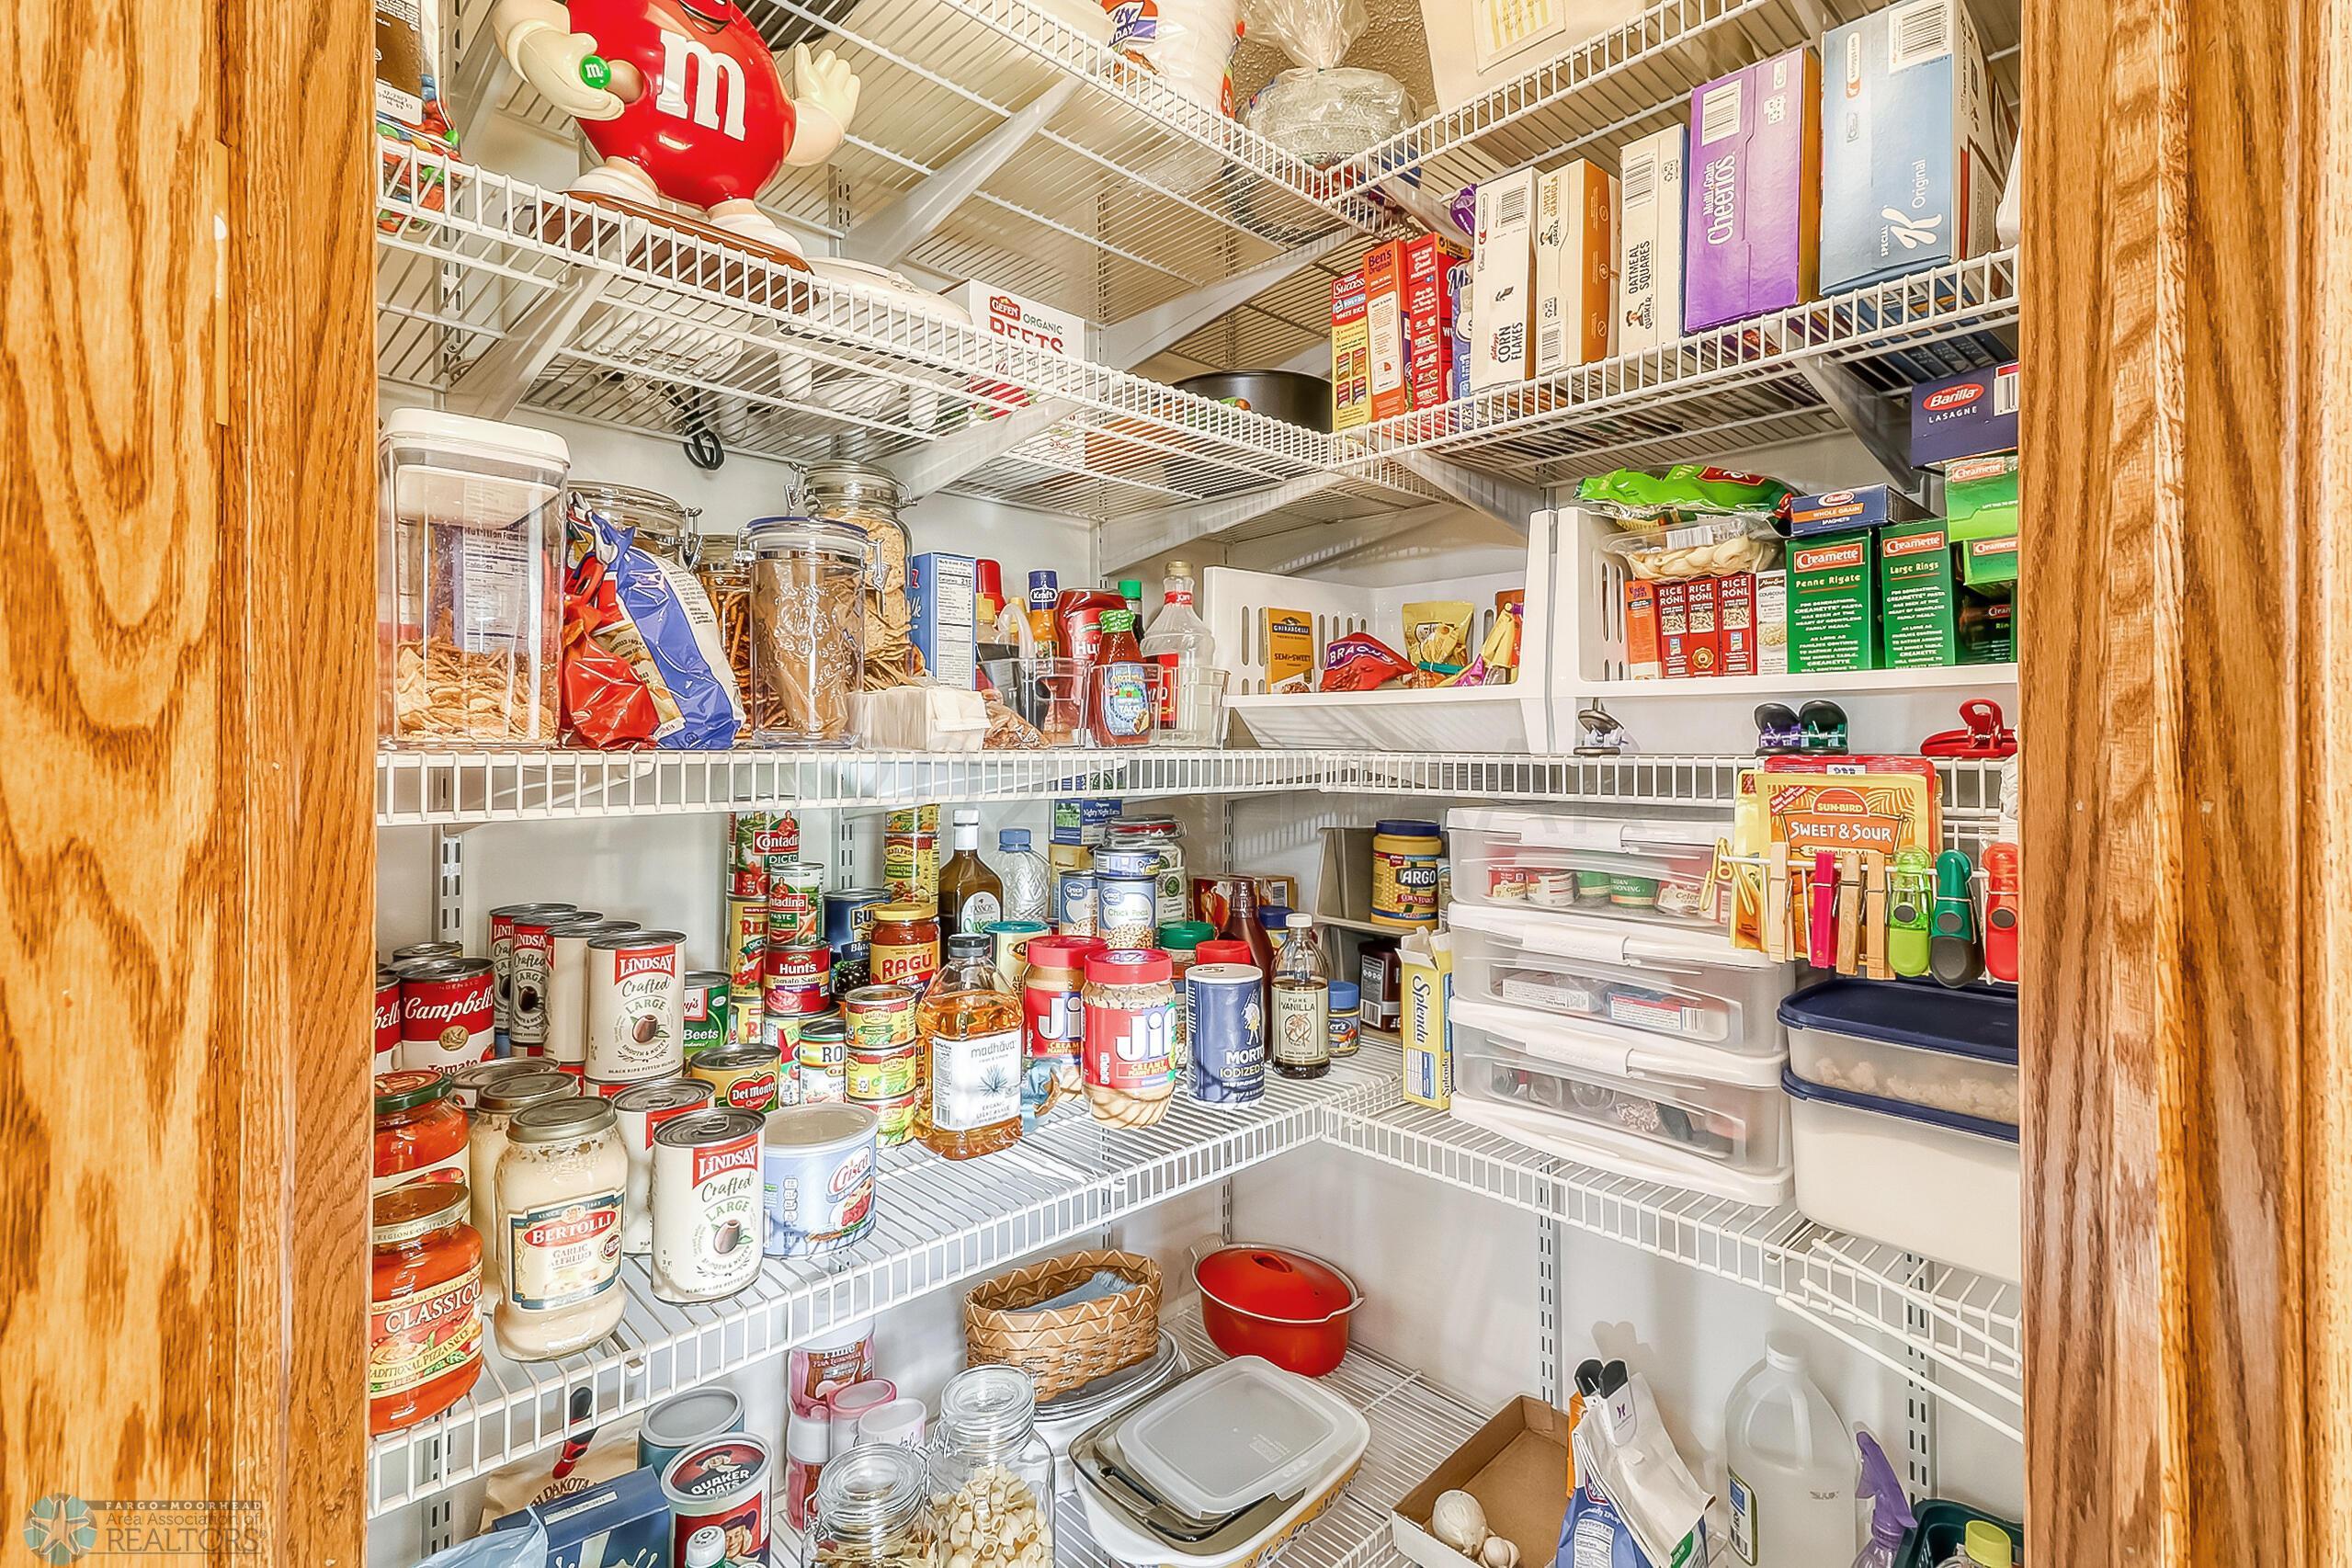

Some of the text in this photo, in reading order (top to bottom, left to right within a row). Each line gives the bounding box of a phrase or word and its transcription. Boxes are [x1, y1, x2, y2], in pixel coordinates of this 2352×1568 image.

[1912, 158, 1927, 210] Original
[1551, 176, 1559, 217] GRANOLA
[1707, 153, 1735, 245] Cheerios
[1880, 224, 1890, 257] SPECIAL
[1369, 249, 1392, 267] Ben's
[1640, 241, 1651, 290] SQUARES
[1629, 244, 1640, 294] OATMEAL
[992, 301, 1018, 316] GEFEN
[1645, 295, 1653, 330] QUAKER
[1023, 313, 1063, 335] ORGANIC
[1498, 325, 1512, 363] CORN
[1511, 322, 1523, 360] FLAKES
[1930, 387, 1978, 408] Barilla
[1929, 405, 1977, 424] LASAGNE
[1813, 506, 1861, 517] WHOLE GRAIN
[1886, 536, 1940, 553] Creamette
[1797, 549, 1858, 568] Creamette
[1890, 561, 1939, 574] Large Rings
[1689, 583, 1711, 593] RICE
[1721, 578, 1746, 588] RICE
[1796, 574, 1861, 588] Penne Rigate
[1033, 590, 1054, 599] Kraft
[1660, 586, 1683, 597] RICE
[1274, 653, 1311, 663] SEMI-SWEET
[1817, 802, 1864, 812] SUN-BIRD
[1790, 821, 1892, 843] SWEET & SOUR
[768, 854, 798, 864] DICED
[1400, 869, 1436, 884] ARGO
[1401, 894, 1418, 903] CORN
[1676, 892, 1699, 903] Celer
[1108, 908, 1129, 916] Chick
[619, 954, 675, 976] LINDSAY
[779, 962, 817, 974] Hunt's
[438, 980, 480, 990] NDENSED
[516, 971, 545, 984] LARGE
[773, 974, 823, 984] Tomato Sauce
[897, 975, 919, 985] PIZZA
[622, 975, 670, 998] Crafted
[625, 998, 666, 1015] LARGE
[1279, 1001, 1315, 1012] VANILLA
[1412, 973, 1431, 1044] Splenda
[1038, 997, 1081, 1040] Ji
[684, 1029, 719, 1040] Beets
[1116, 1006, 1176, 1061] Jif
[621, 1044, 644, 1056] SMOOTH
[650, 1040, 667, 1054] NUTTY
[427, 1060, 478, 1074] Tomato
[1131, 1061, 1165, 1071] CREAMY
[1220, 1064, 1260, 1079] IODIZED
[1441, 1056, 1450, 1098] Splenda
[732, 1081, 775, 1101] Del Monte
[698, 1144, 758, 1180] LINDSAY
[832, 1153, 870, 1192] Crisco
[701, 1171, 755, 1202] Crafted
[706, 1199, 750, 1222] LARGE
[429, 1220, 449, 1231] ITALY
[531, 1213, 612, 1244] BERTOLLI
[552, 1243, 588, 1258] GARLIC
[385, 1278, 481, 1334] CLASSICO
[422, 1345, 447, 1367] PIZZA
[546, 1476, 588, 1504] DAKOTA
[691, 1470, 750, 1495] QUAKER
[706, 1483, 740, 1496] OATS
